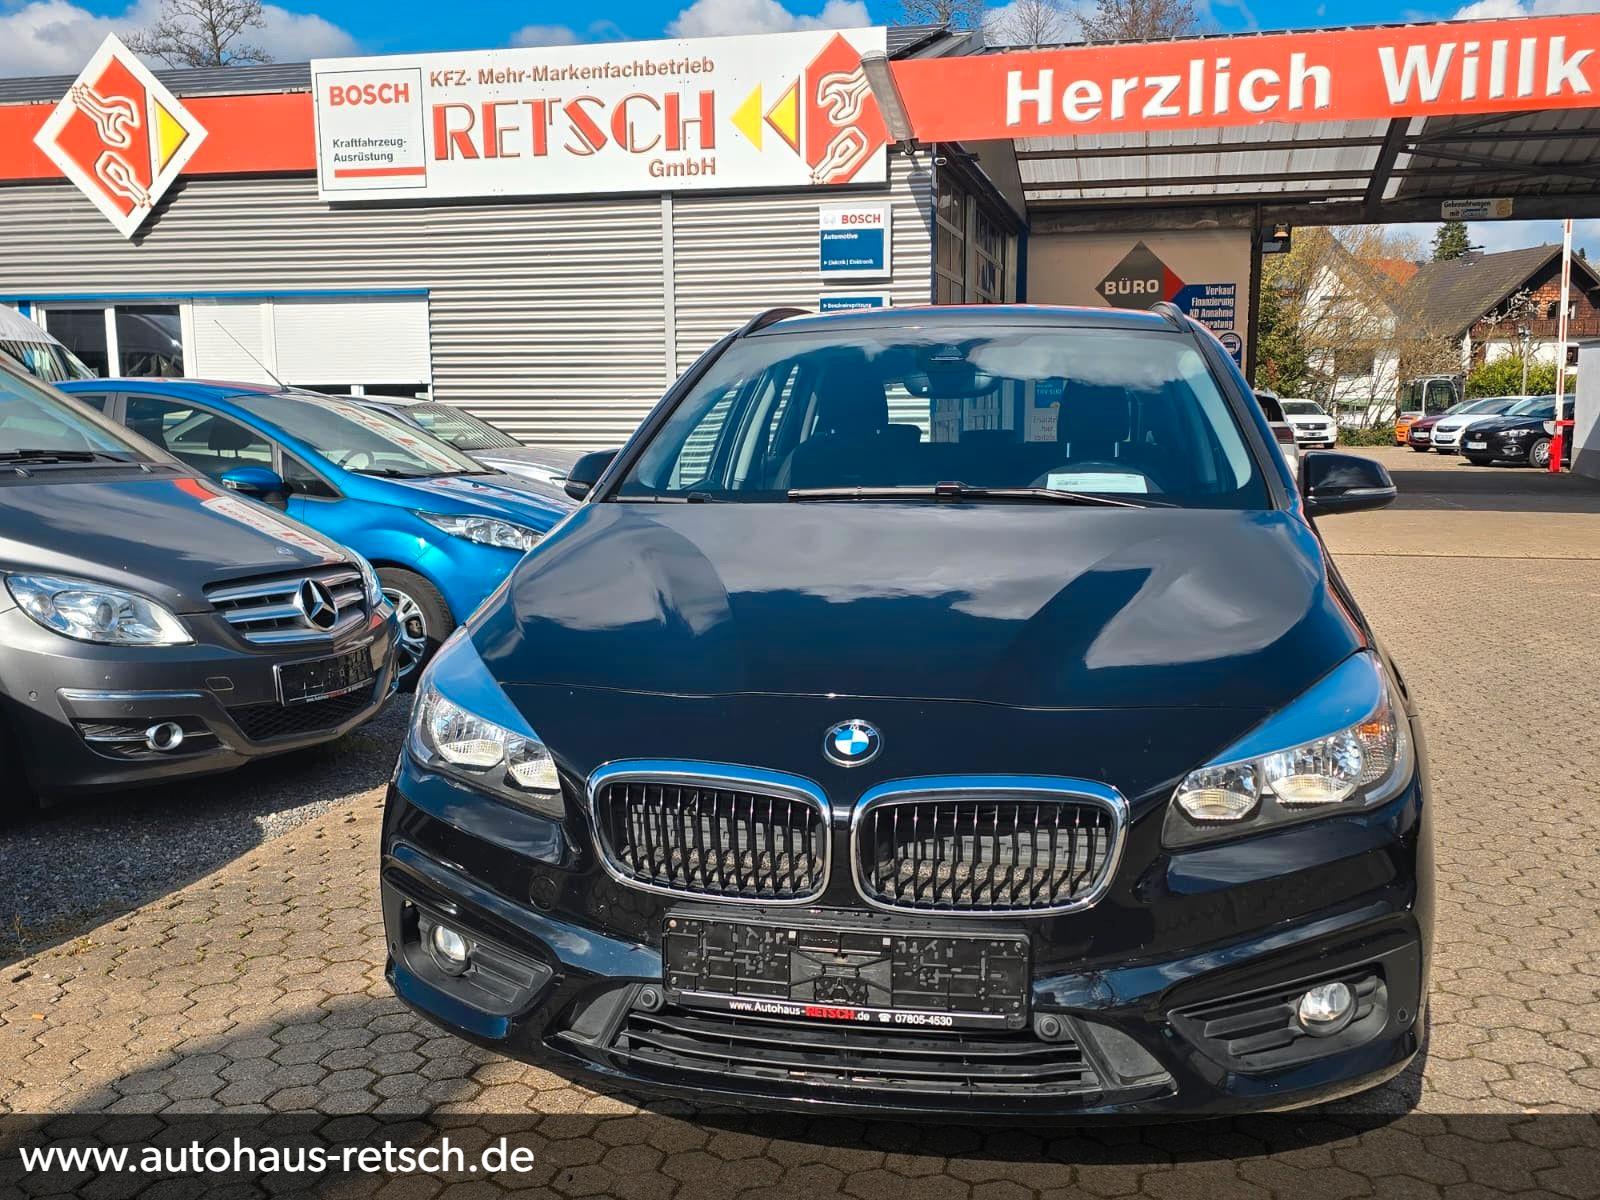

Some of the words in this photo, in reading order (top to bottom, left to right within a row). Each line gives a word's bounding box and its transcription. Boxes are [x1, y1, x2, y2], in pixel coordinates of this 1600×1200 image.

[429, 69, 472, 88] KFZ-
[478, 56, 715, 86] Mehr-Markenfachbetrieb
[1005, 51, 1333, 126] Herzlich
[1377, 35, 1595, 106] Willk
[329, 83, 410, 106] BOSCH
[432, 89, 716, 161] RETSCH
[332, 136, 408, 151] Kraftfahrzeug-
[333, 150, 394, 164] Ausrüstung
[648, 155, 716, 178] GmbH
[1443, 199, 1491, 209] Gebrauchtwagen
[841, 213, 881, 225] BOSCH
[823, 233, 859, 241] Automotive
[1104, 277, 1160, 295] BÜRO
[1205, 285, 1234, 296] Verkauf
[1191, 296, 1234, 307] Finanzierung
[1201, 307, 1233, 318] Annahme
[729, 1000, 870, 1022] www.Autohaus-RETSCH.de
[894, 1013, 953, 1027] 07805-4530
